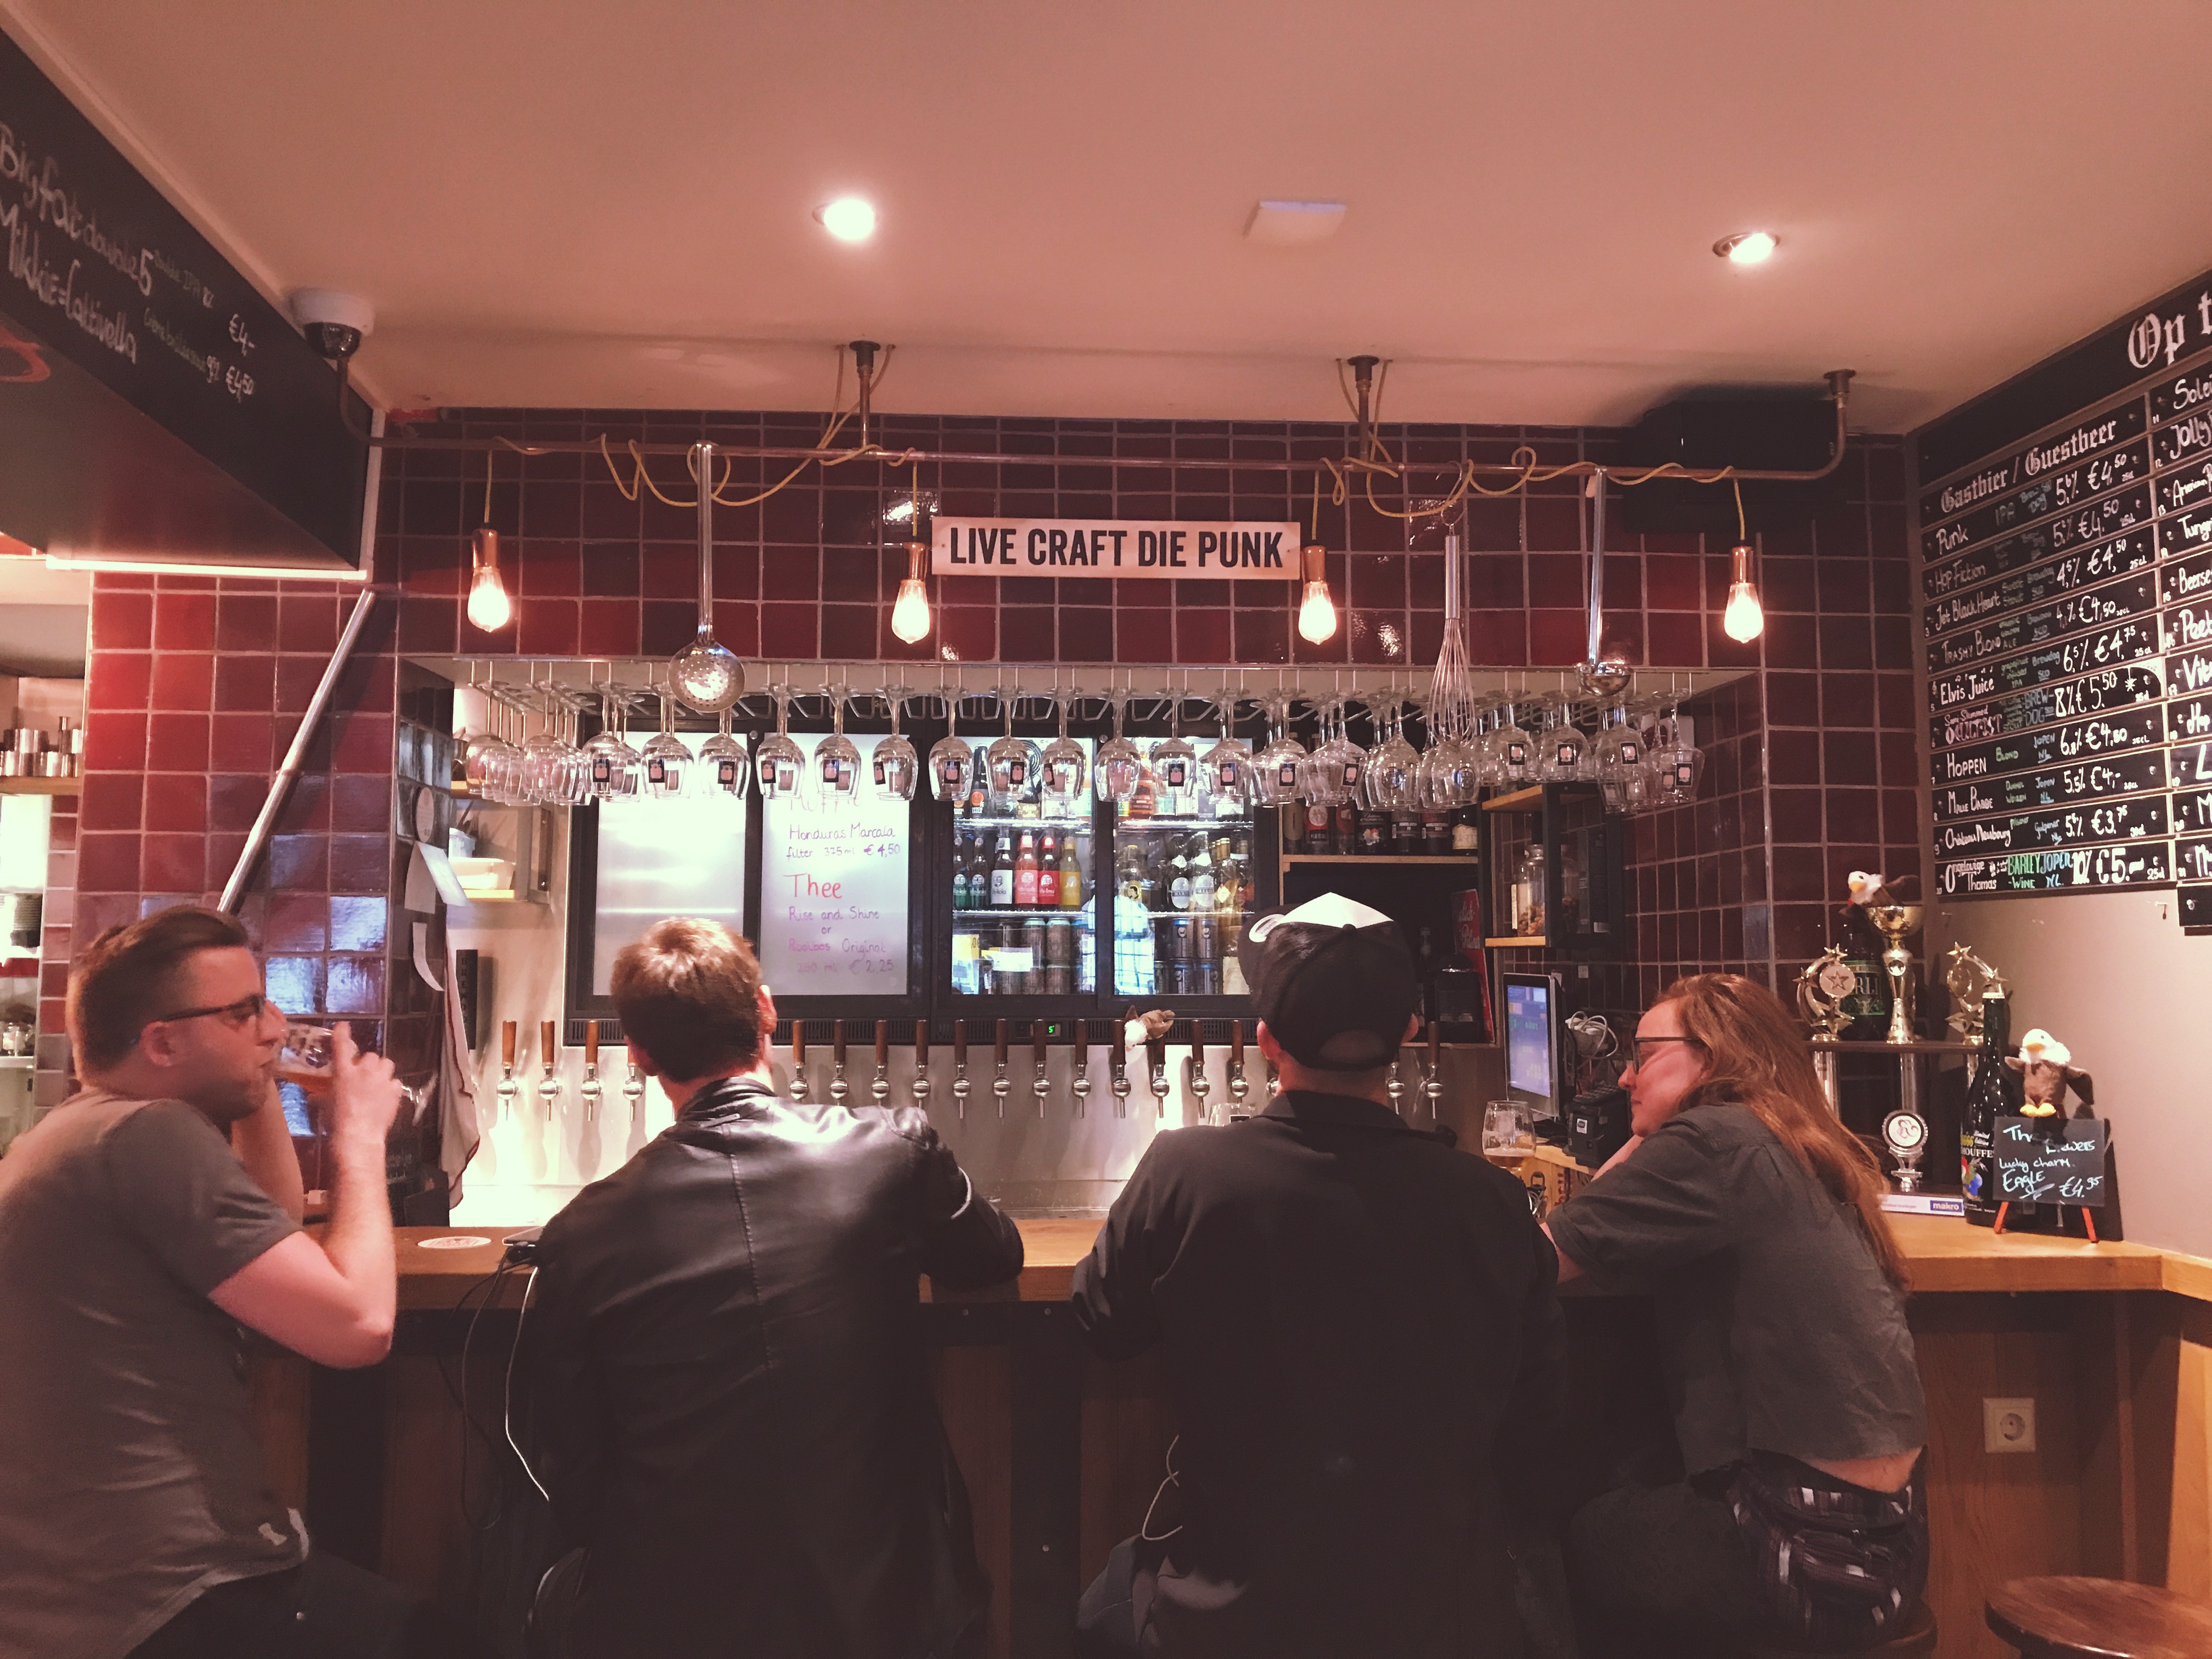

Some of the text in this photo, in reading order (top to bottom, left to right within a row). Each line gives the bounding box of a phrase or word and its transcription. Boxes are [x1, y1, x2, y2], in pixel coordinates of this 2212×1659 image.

[2128, 313, 2185, 368] Op
[2025, 420, 2117, 476] Guestbeer
[2170, 416, 2211, 460] Jolly
[950, 527, 1283, 568] LIVE CRAFT DIE PUNK
[1936, 524, 1968, 555] Punk
[1940, 682, 1965, 705] Elvis
[1968, 674, 1994, 700] Juice
[1946, 753, 1986, 778] HOPPEN
[789, 822, 896, 840] Honduras Marcala
[786, 847, 814, 861] filter
[2008, 854, 2040, 876] BARLEY
[783, 873, 843, 899] Thee
[789, 906, 879, 921] Rise and Shine
[821, 926, 832, 935] or
[2002, 1124, 2036, 1142] Th
[1933, 1203, 1959, 1211] makro
